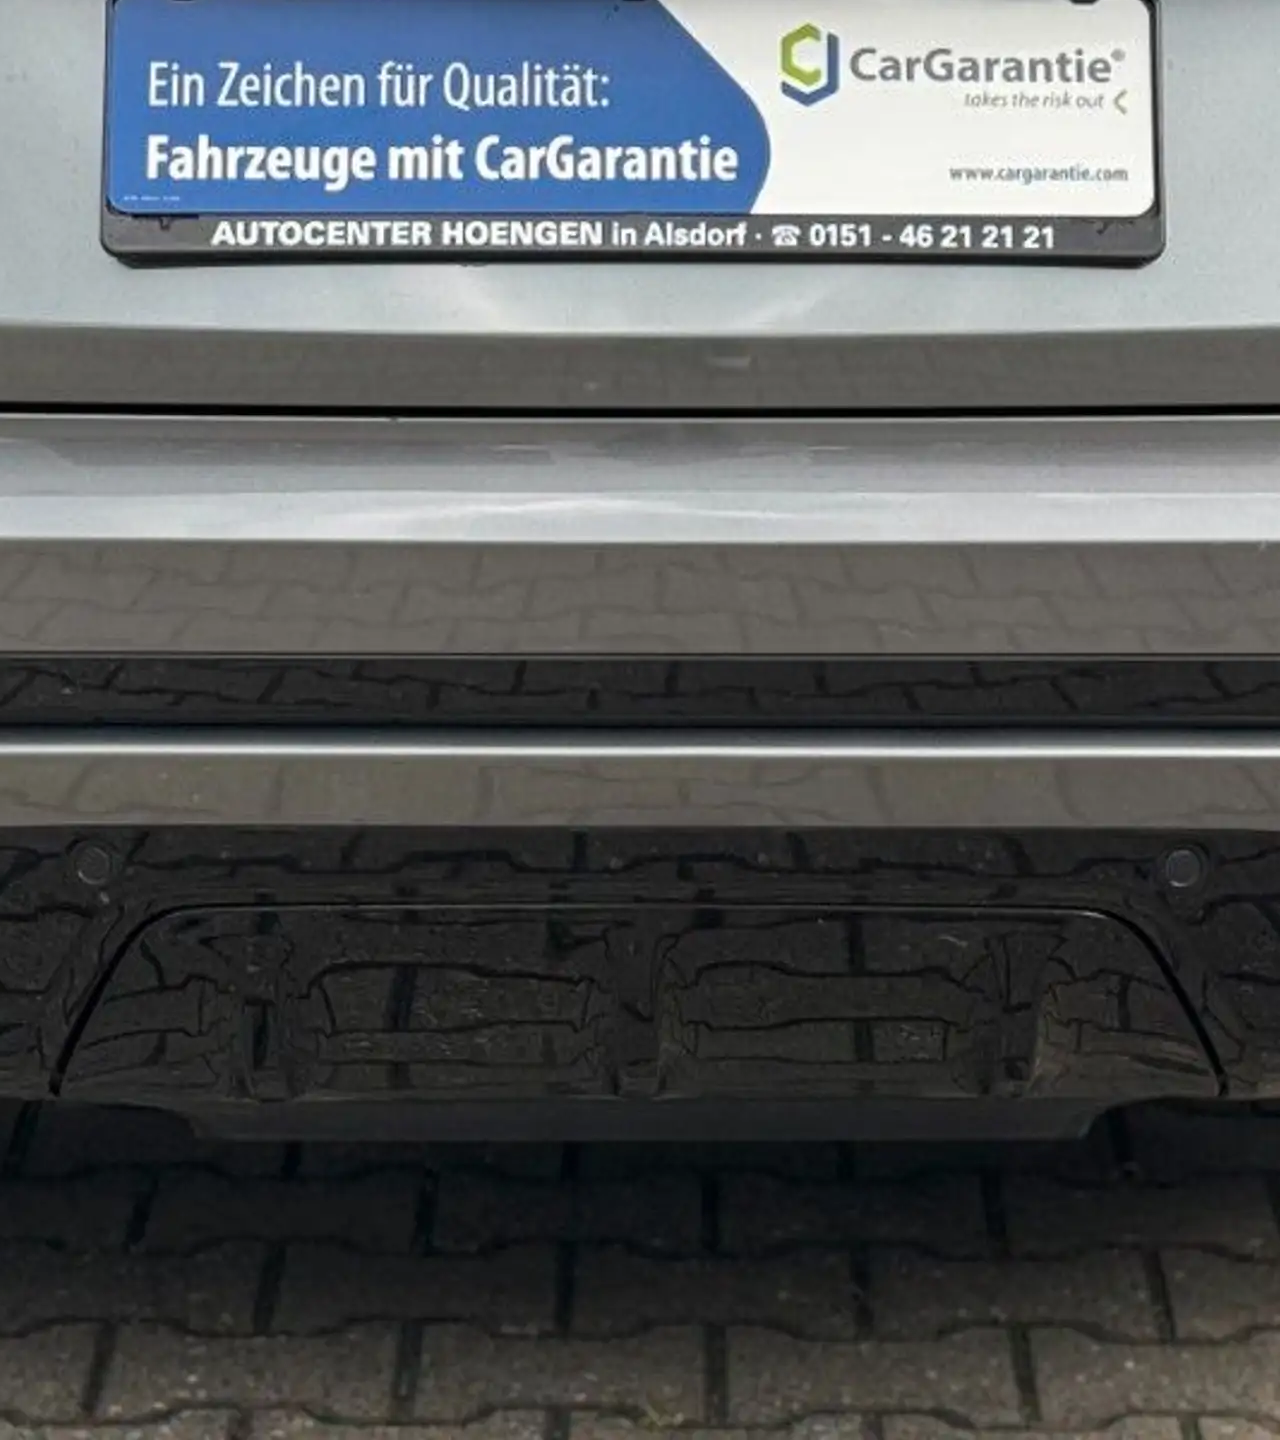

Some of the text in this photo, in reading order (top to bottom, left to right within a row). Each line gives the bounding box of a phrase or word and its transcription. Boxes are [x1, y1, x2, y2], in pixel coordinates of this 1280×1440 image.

[148, 60, 610, 113] Ein Zeichen für Qualität:
[1011, 91, 1039, 108] the
[1042, 91, 1072, 108] risk
[1076, 94, 1105, 109] out
[146, 133, 739, 193] Fahrzeuge mit CarGarantie
[949, 166, 1129, 185] www.cargarantie.com
[211, 221, 432, 250] AUTOCENTER
[440, 221, 605, 250] HOENGEN
[611, 221, 636, 249] in
[643, 220, 748, 249] Alsdorf
[808, 222, 873, 249] 0151
[900, 222, 934, 249] 46
[939, 222, 974, 249] 21
[980, 222, 1015, 249] 21
[1020, 222, 1055, 249] 21
